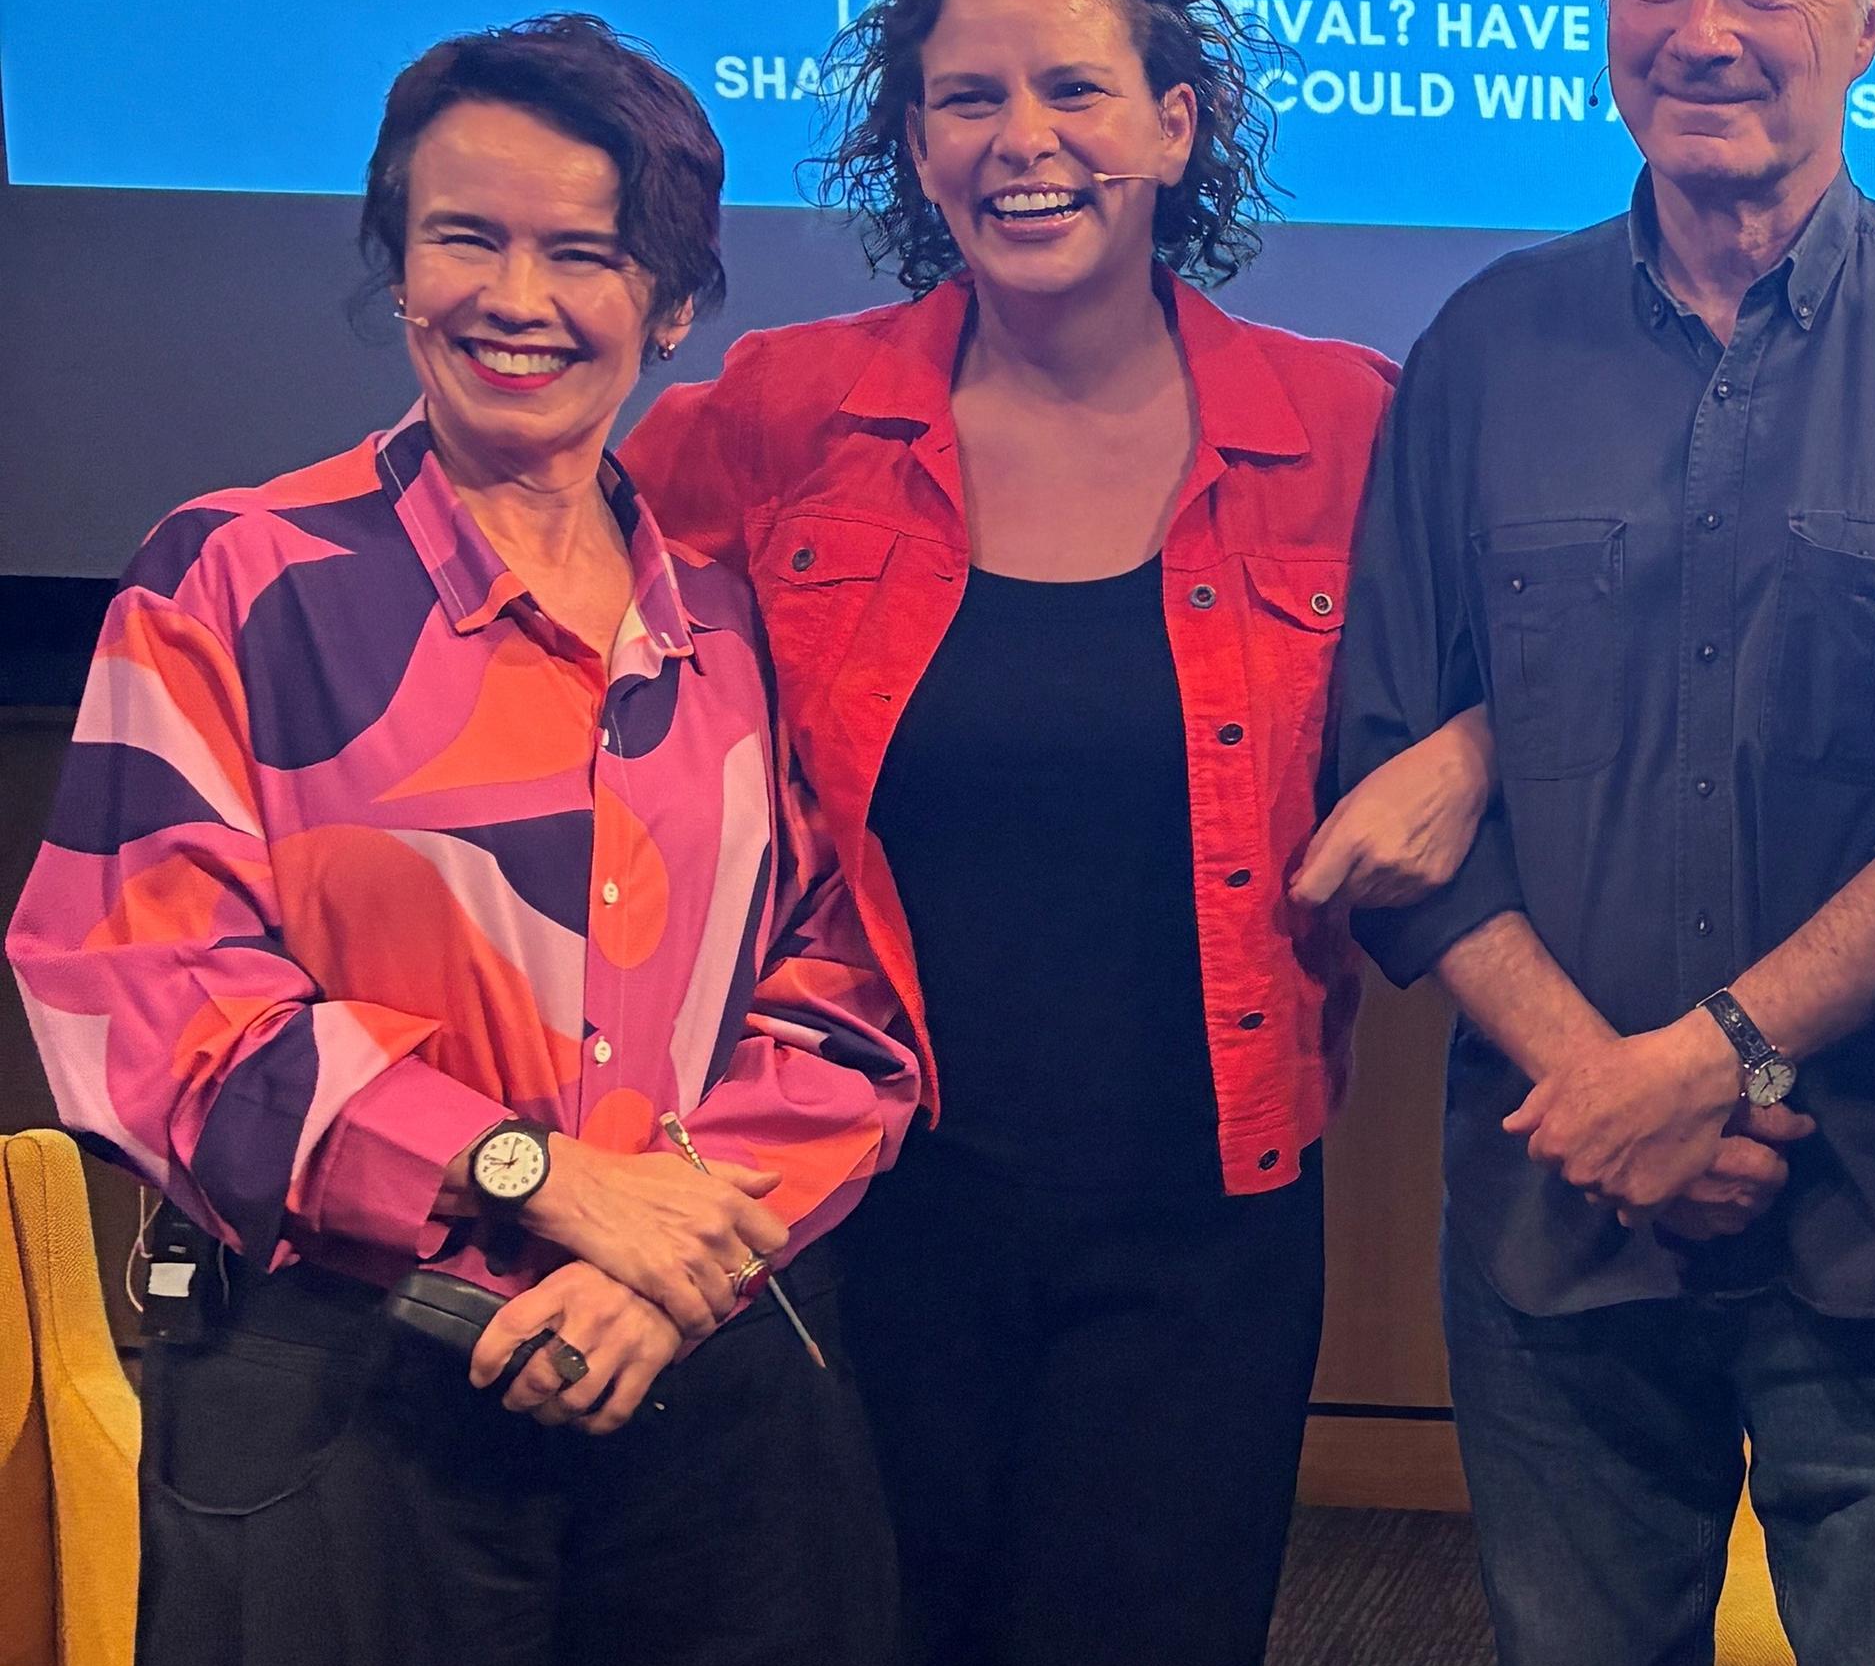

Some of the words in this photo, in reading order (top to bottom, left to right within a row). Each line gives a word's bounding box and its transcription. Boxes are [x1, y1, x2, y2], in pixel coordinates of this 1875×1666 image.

[1437, 2, 1590, 51] HAVE
[714, 55, 824, 100] SHA
[1258, 68, 1455, 117] COULD
[1473, 73, 1585, 122] WIN
